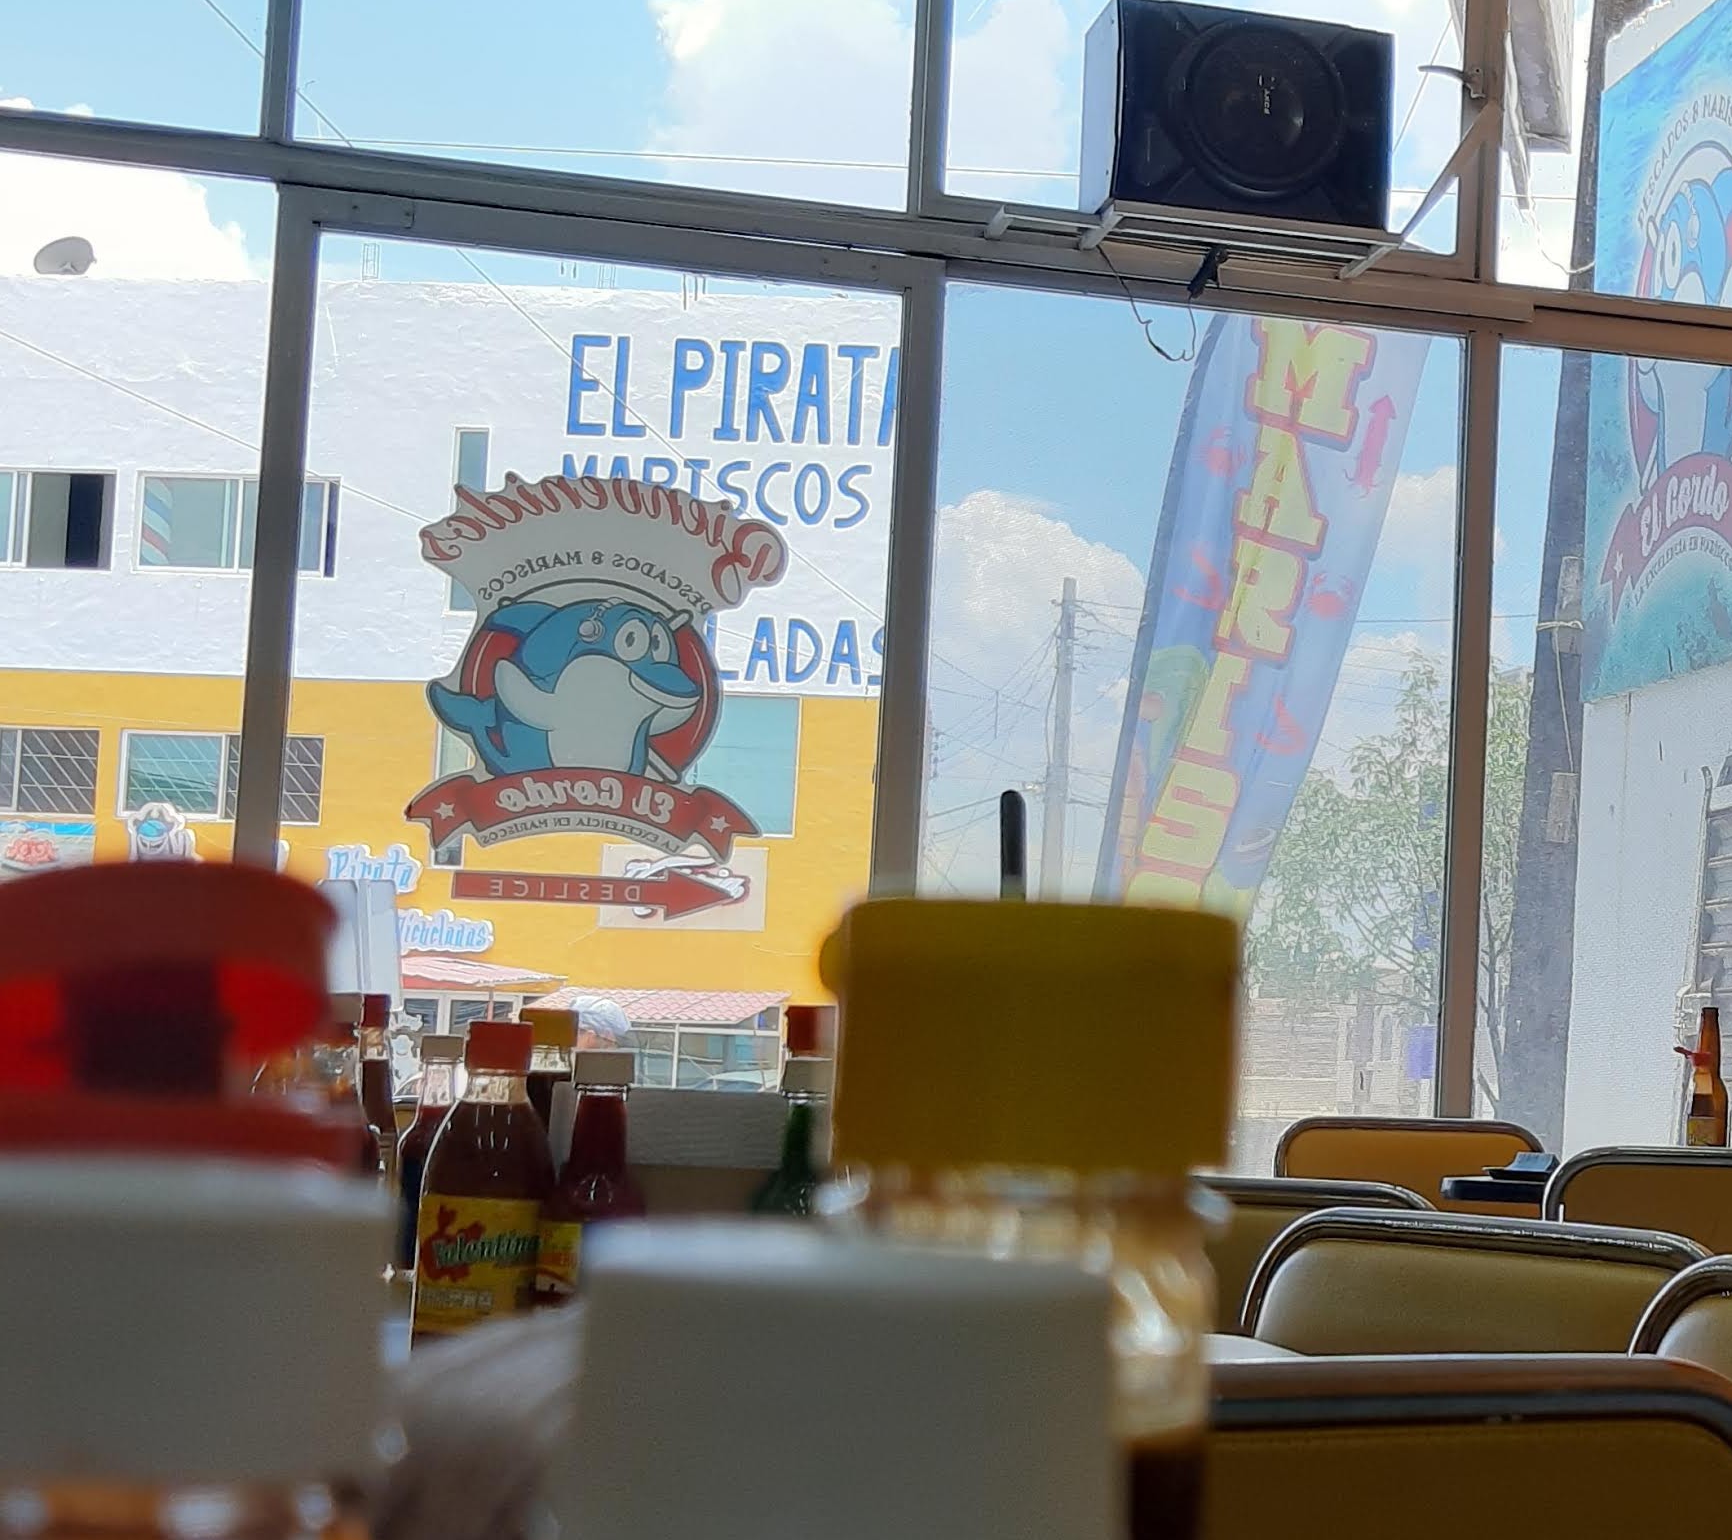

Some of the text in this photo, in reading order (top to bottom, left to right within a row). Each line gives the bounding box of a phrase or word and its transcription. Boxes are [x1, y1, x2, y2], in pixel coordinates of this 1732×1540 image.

[1638, 110, 1689, 229] PESCADOS
[566, 334, 647, 437] EL
[1641, 464, 1730, 556] El Gordo
[332, 850, 413, 887] Pirata
